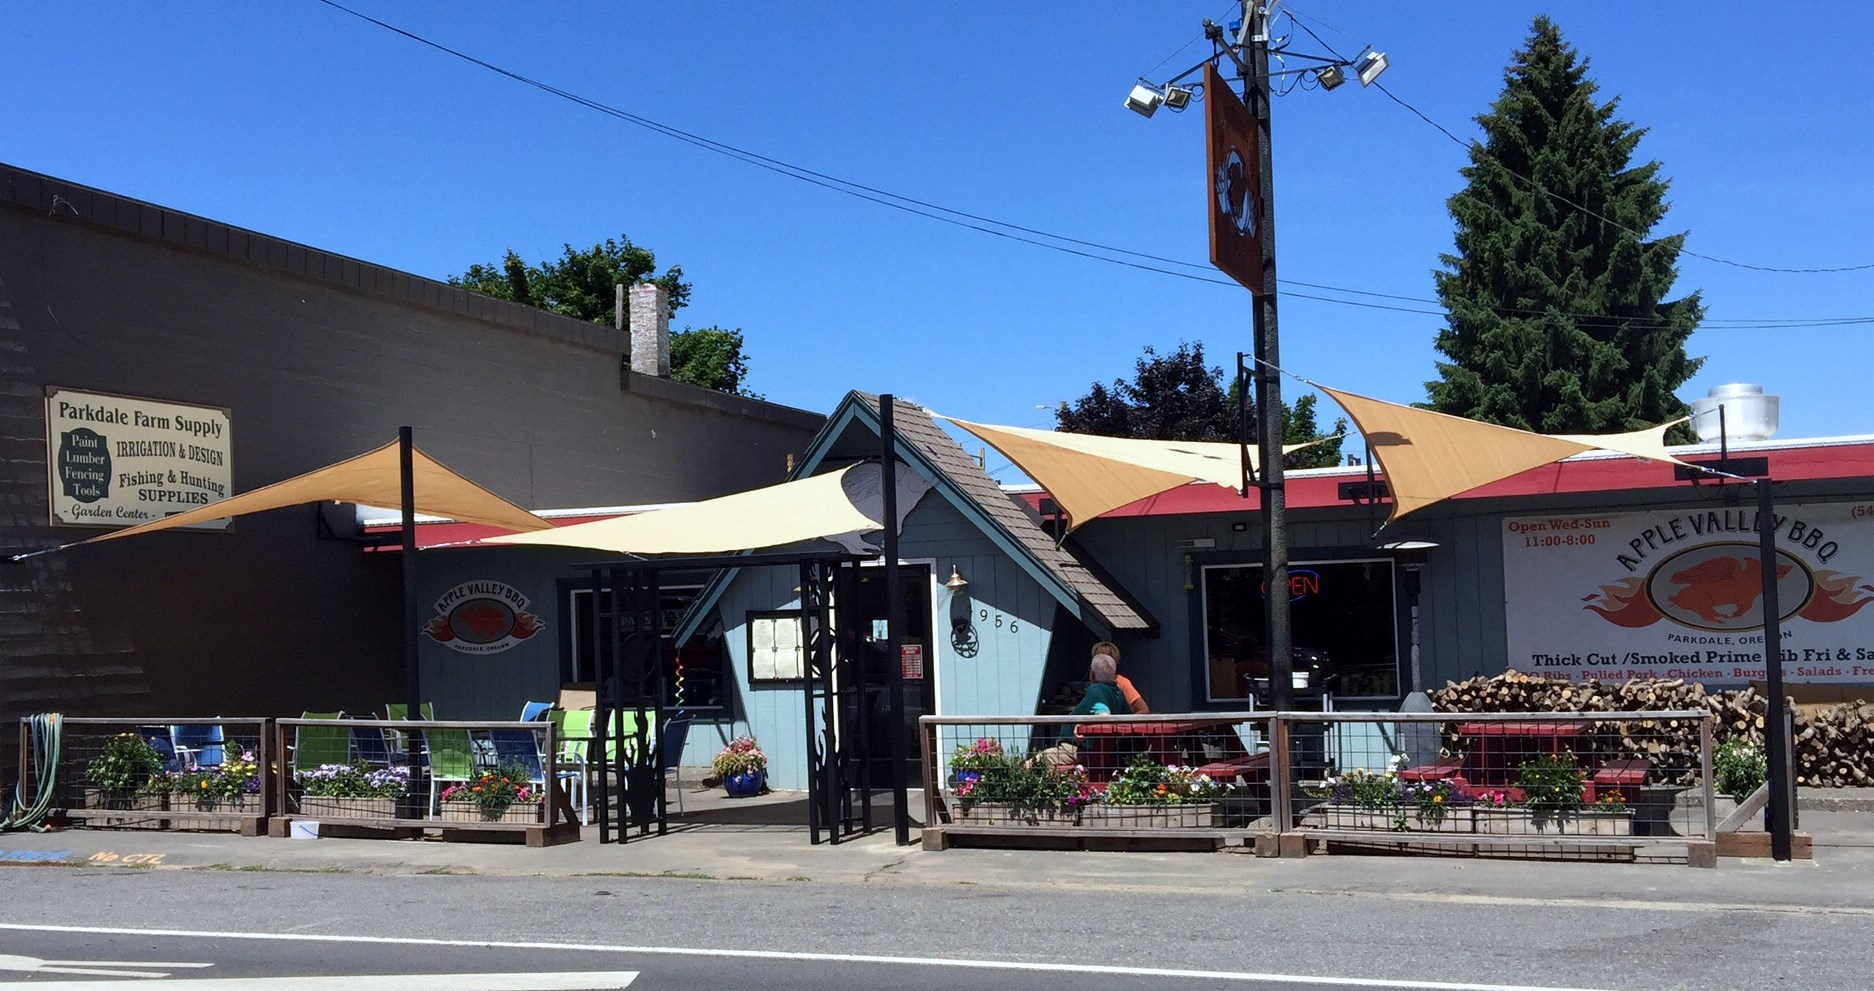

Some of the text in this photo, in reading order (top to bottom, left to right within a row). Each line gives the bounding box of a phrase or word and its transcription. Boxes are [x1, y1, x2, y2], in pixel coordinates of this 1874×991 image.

[58, 401, 223, 439] Parkdale Farm Supply
[71, 434, 98, 448] Paint
[65, 450, 105, 465] Lumber
[116, 440, 223, 467] IRRIGATION & DESIGN
[64, 467, 105, 483] Fencing
[73, 484, 101, 497] Tools
[119, 470, 225, 498] Fishing & Hunting
[138, 488, 209, 505] SUPPLIES
[71, 504, 149, 520] Garden Center
[1508, 518, 1611, 534] Open Wed-Sun
[1524, 534, 1596, 547] 11:00-8:00
[1616, 517, 1688, 573] APPLE
[1787, 520, 1840, 564] BBQ
[1261, 576, 1319, 596] EN
[437, 582, 526, 612] APPLE VALLEY BBQ
[1667, 630, 1793, 646] PARKDALE, OREN
[1532, 653, 1582, 666] Thick
[1586, 653, 1618, 666] Cut
[1622, 651, 1701, 665] /Smoked
[1706, 650, 1762, 664] Prime
[1778, 649, 1798, 662] ib
[1803, 648, 1831, 661] Fri
[1836, 648, 1851, 661] &
[1543, 670, 1572, 680] Ribs
[1581, 669, 1623, 680] Pulled
[1626, 668, 1657, 679] Pork
[1667, 668, 1723, 679] Chicken
[1733, 667, 1787, 679] Burgs
[1796, 666, 1842, 678] Salads
